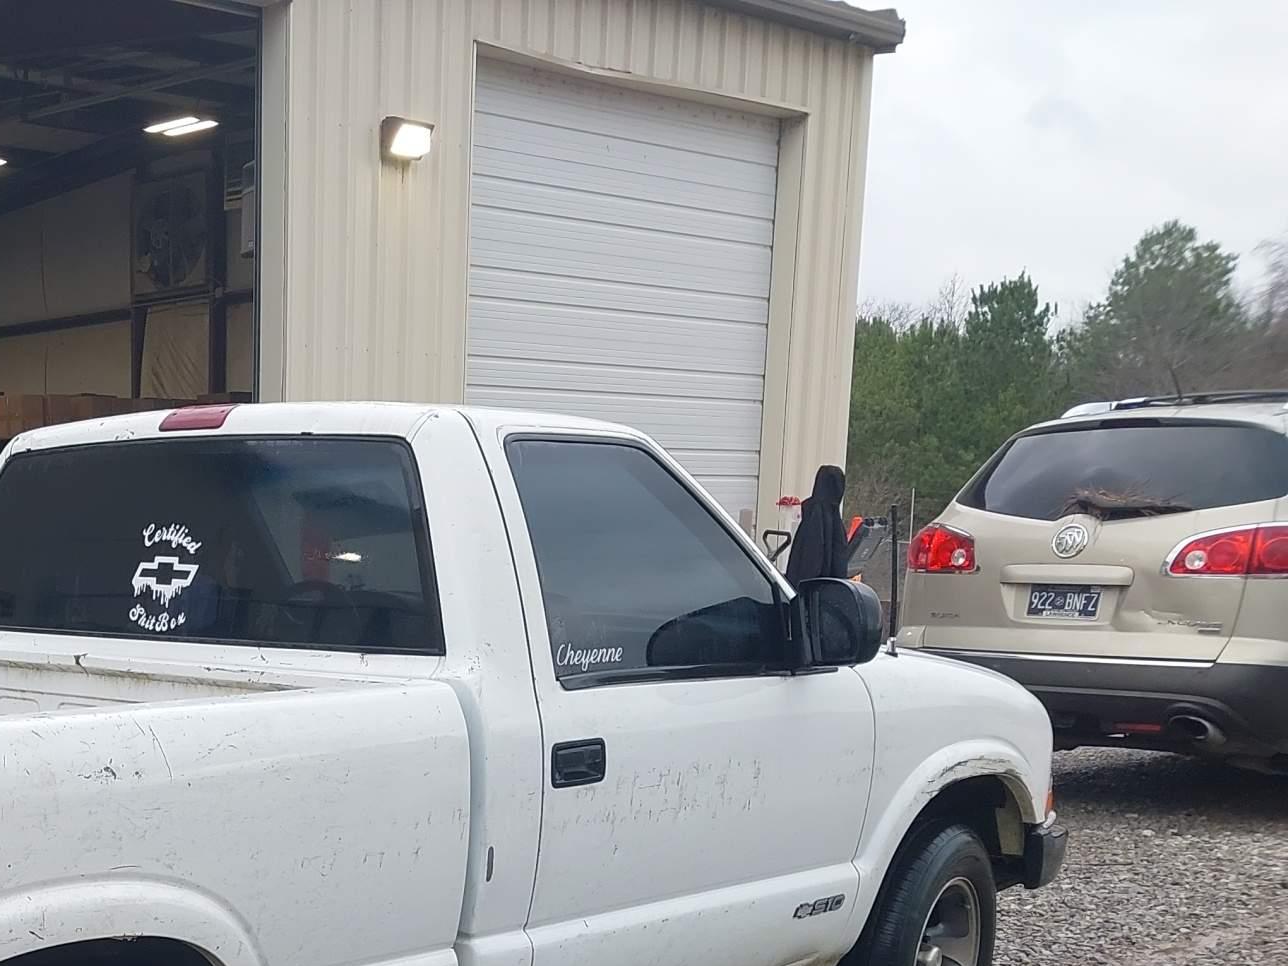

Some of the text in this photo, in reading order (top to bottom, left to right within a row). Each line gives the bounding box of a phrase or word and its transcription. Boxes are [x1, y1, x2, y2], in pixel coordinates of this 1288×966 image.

[142, 523, 202, 554] Certified
[1031, 592, 1099, 611] 922 BNFZ
[556, 643, 623, 672] Cheyenne
